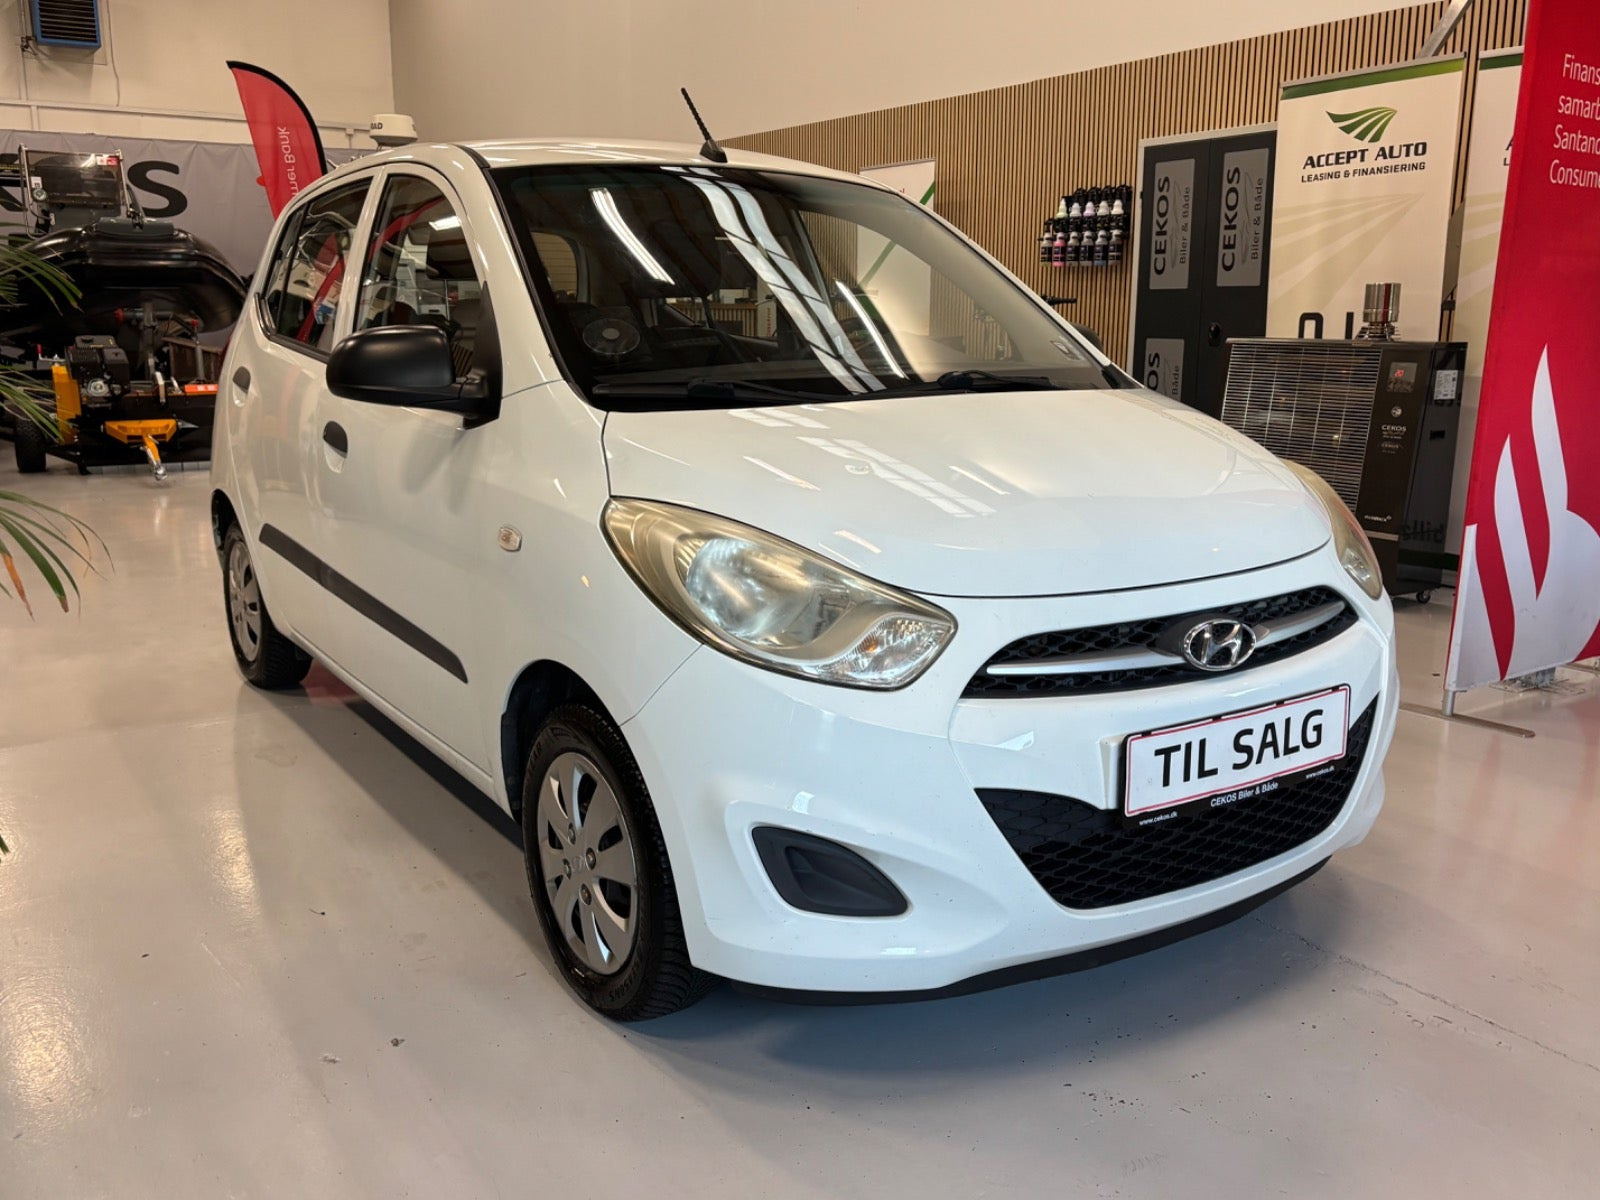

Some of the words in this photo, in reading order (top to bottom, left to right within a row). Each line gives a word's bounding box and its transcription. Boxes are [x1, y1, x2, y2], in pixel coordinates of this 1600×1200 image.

[1302, 148, 1369, 170] ACCEPT
[1374, 141, 1428, 161] AUTO
[1301, 171, 1341, 183] LEASING
[1343, 169, 1351, 178] &
[1352, 161, 1426, 177] FINANSIERING
[1182, 187, 1191, 220] Både
[1254, 177, 1264, 211] Både
[1154, 176, 1170, 275] CEKOS
[1181, 223, 1188, 232] &
[1222, 166, 1241, 272] CEKOS
[1253, 216, 1261, 226] &
[1179, 236, 1188, 264] Biler
[1251, 231, 1260, 260] Biler
[1154, 737, 1219, 788] TIL
[1232, 709, 1324, 771] SALG
[1210, 792, 1237, 808] CEKOS
[1238, 788, 1254, 800] Biler
[1255, 785, 1260, 795] &
[1261, 781, 1279, 793] Både
[1139, 810, 1178, 826] www.cekos.dk
